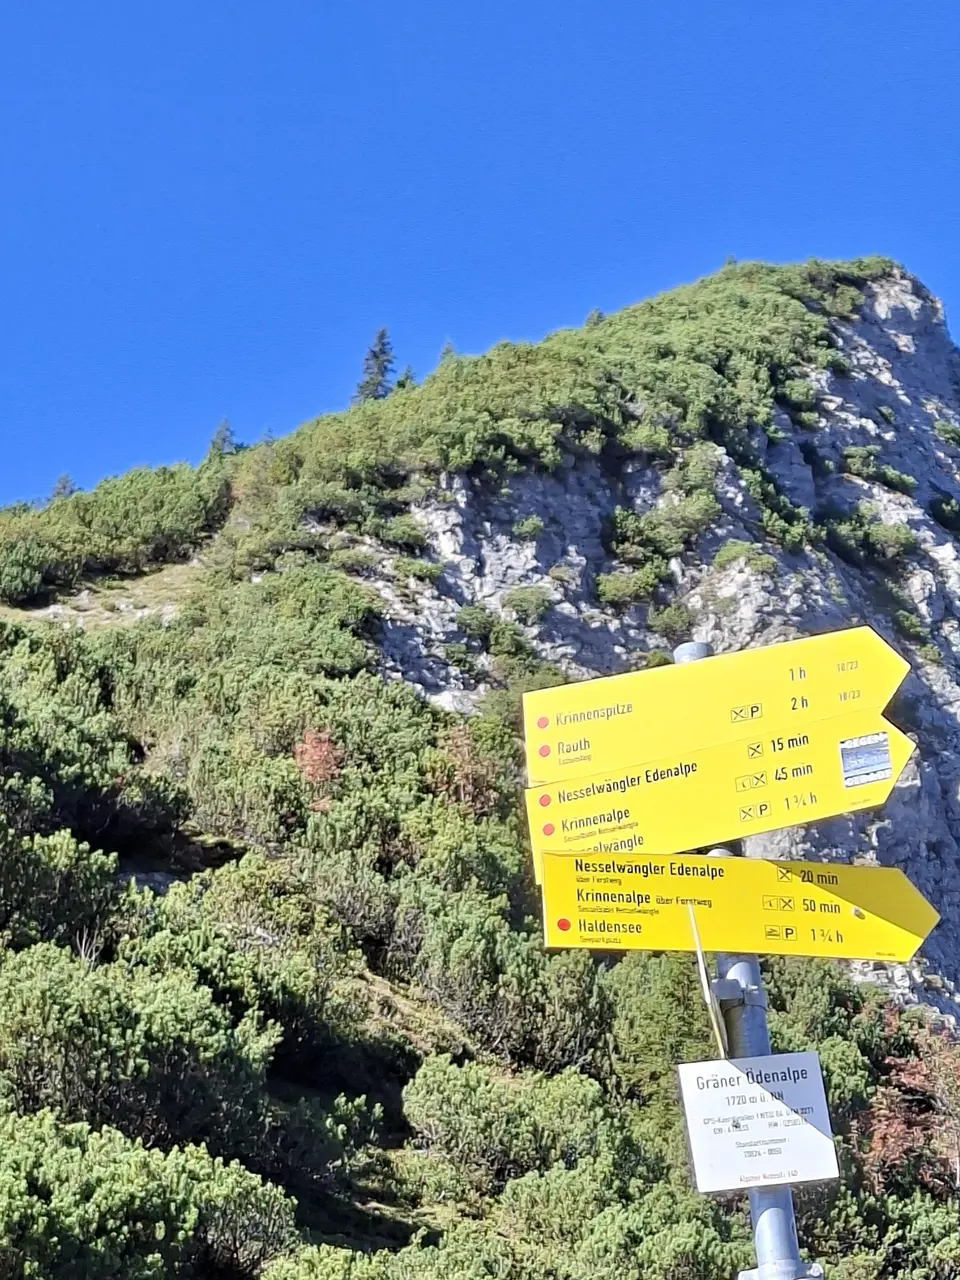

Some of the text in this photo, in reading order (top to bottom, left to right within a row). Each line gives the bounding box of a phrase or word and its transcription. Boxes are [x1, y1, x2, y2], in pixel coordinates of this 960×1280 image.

[789, 666, 806, 681] 1 h
[790, 698, 798, 710] 2
[801, 696, 808, 708] h
[556, 703, 633, 726] Krinnenspitze
[558, 738, 591, 755] Rauth
[771, 733, 809, 753] 15 min
[774, 763, 813, 781] 45 min
[558, 761, 698, 804] Nesselwängler Edenalpe
[809, 791, 817, 804] h
[562, 808, 631, 833] Krinnenalpe
[575, 858, 725, 881] Nesselwängler Edenalpe
[800, 869, 839, 885] 20 min
[576, 888, 651, 906] Krinnenalpe
[802, 898, 841, 914] 50 min
[578, 919, 642, 934] Haldensee
[836, 930, 844, 943] h
[696, 1066, 808, 1090] Gräner Ödenalpe
[726, 1094, 747, 1107] 1720
[749, 1096, 758, 1104] m
